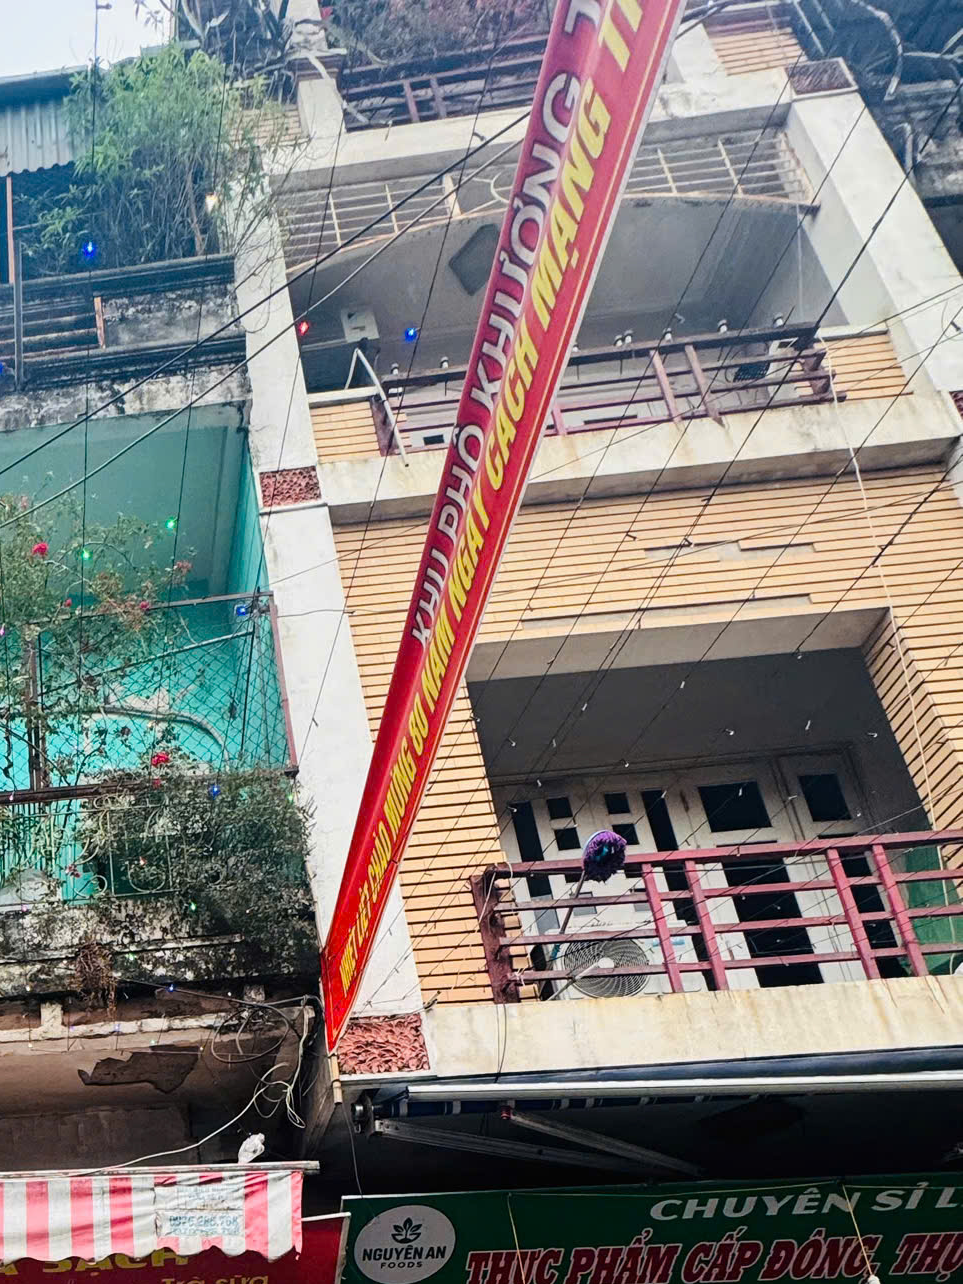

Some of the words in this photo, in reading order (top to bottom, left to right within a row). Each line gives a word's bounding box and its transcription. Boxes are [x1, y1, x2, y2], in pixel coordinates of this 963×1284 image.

[408, 692, 429, 757] 80
[531, 77, 612, 332] MẠNG
[650, 1187, 861, 1221] CHUYÊN
[871, 1181, 929, 1212] SỈ
[935, 1186, 963, 1209] L
[362, 1244, 424, 1262] NGUYÊN
[425, 1246, 447, 1259] AN
[380, 1261, 423, 1269] FOODS
[680, 1225, 765, 1284] CẤP
